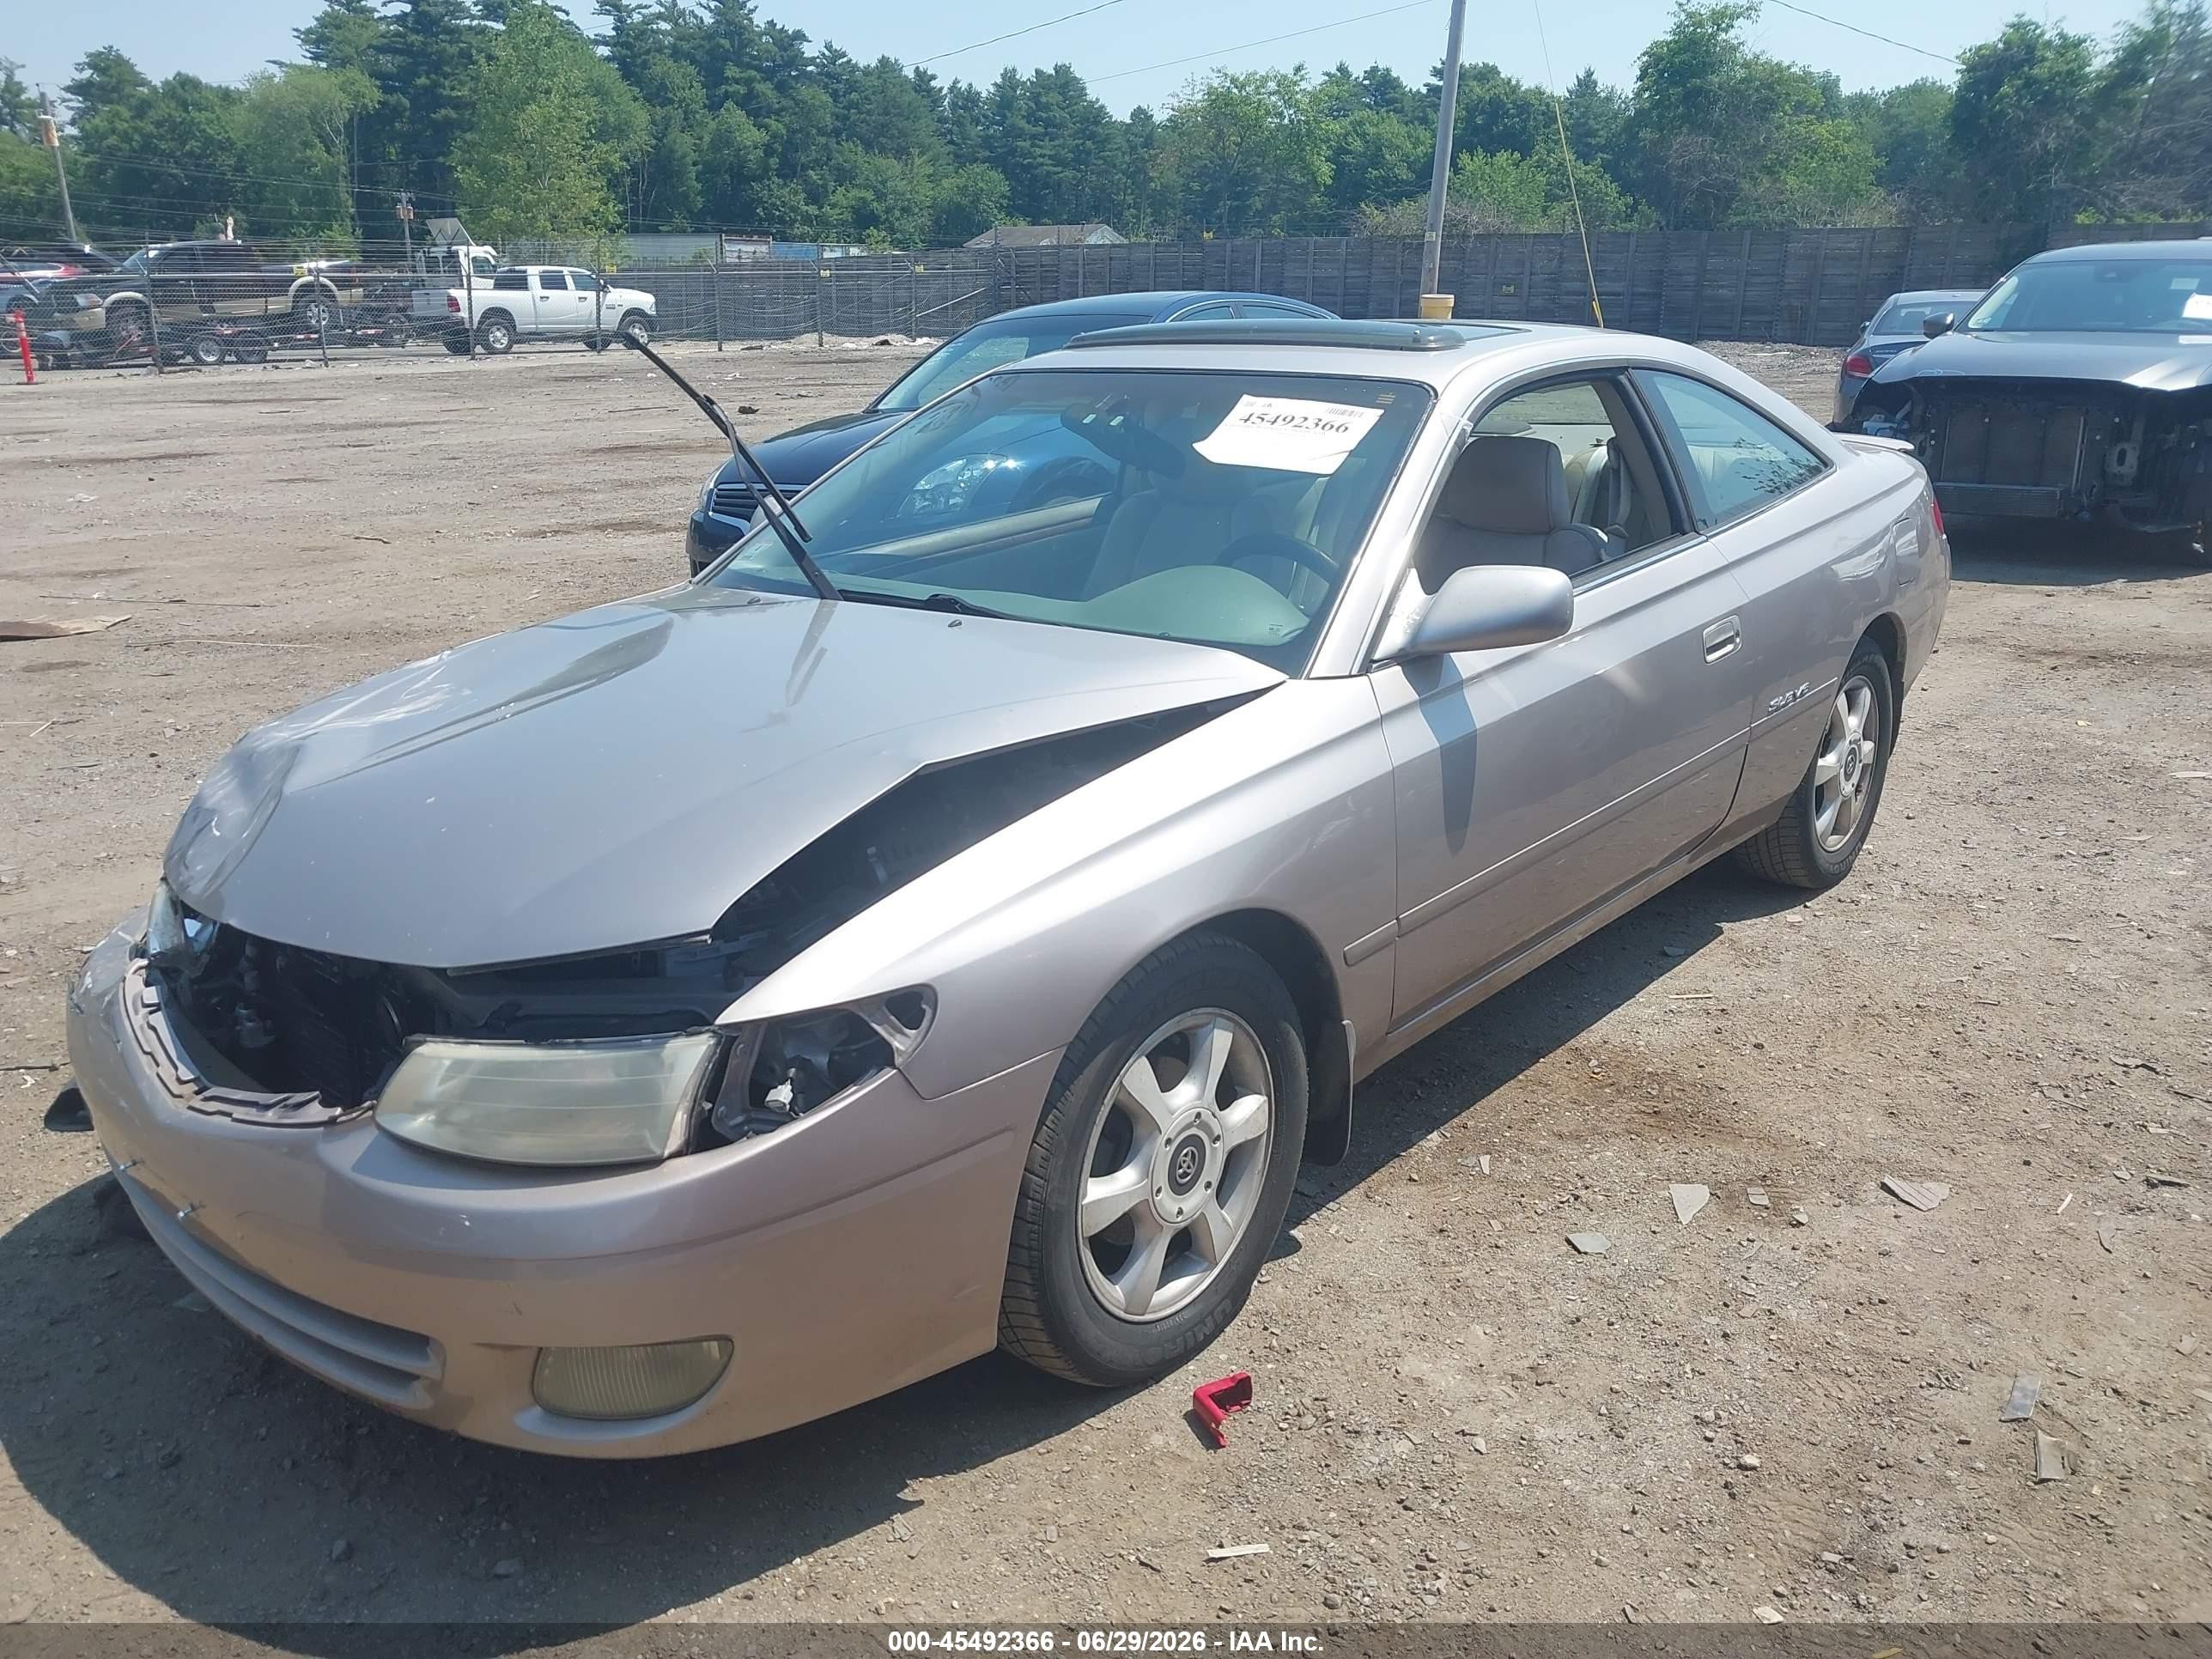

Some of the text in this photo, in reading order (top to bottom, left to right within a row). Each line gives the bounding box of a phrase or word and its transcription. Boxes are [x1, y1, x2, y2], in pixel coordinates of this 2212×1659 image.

[1239, 411, 1353, 434] 45492366
[1822, 841, 1863, 874] UNIROY
[1121, 1297, 1233, 1369] UNIRO
